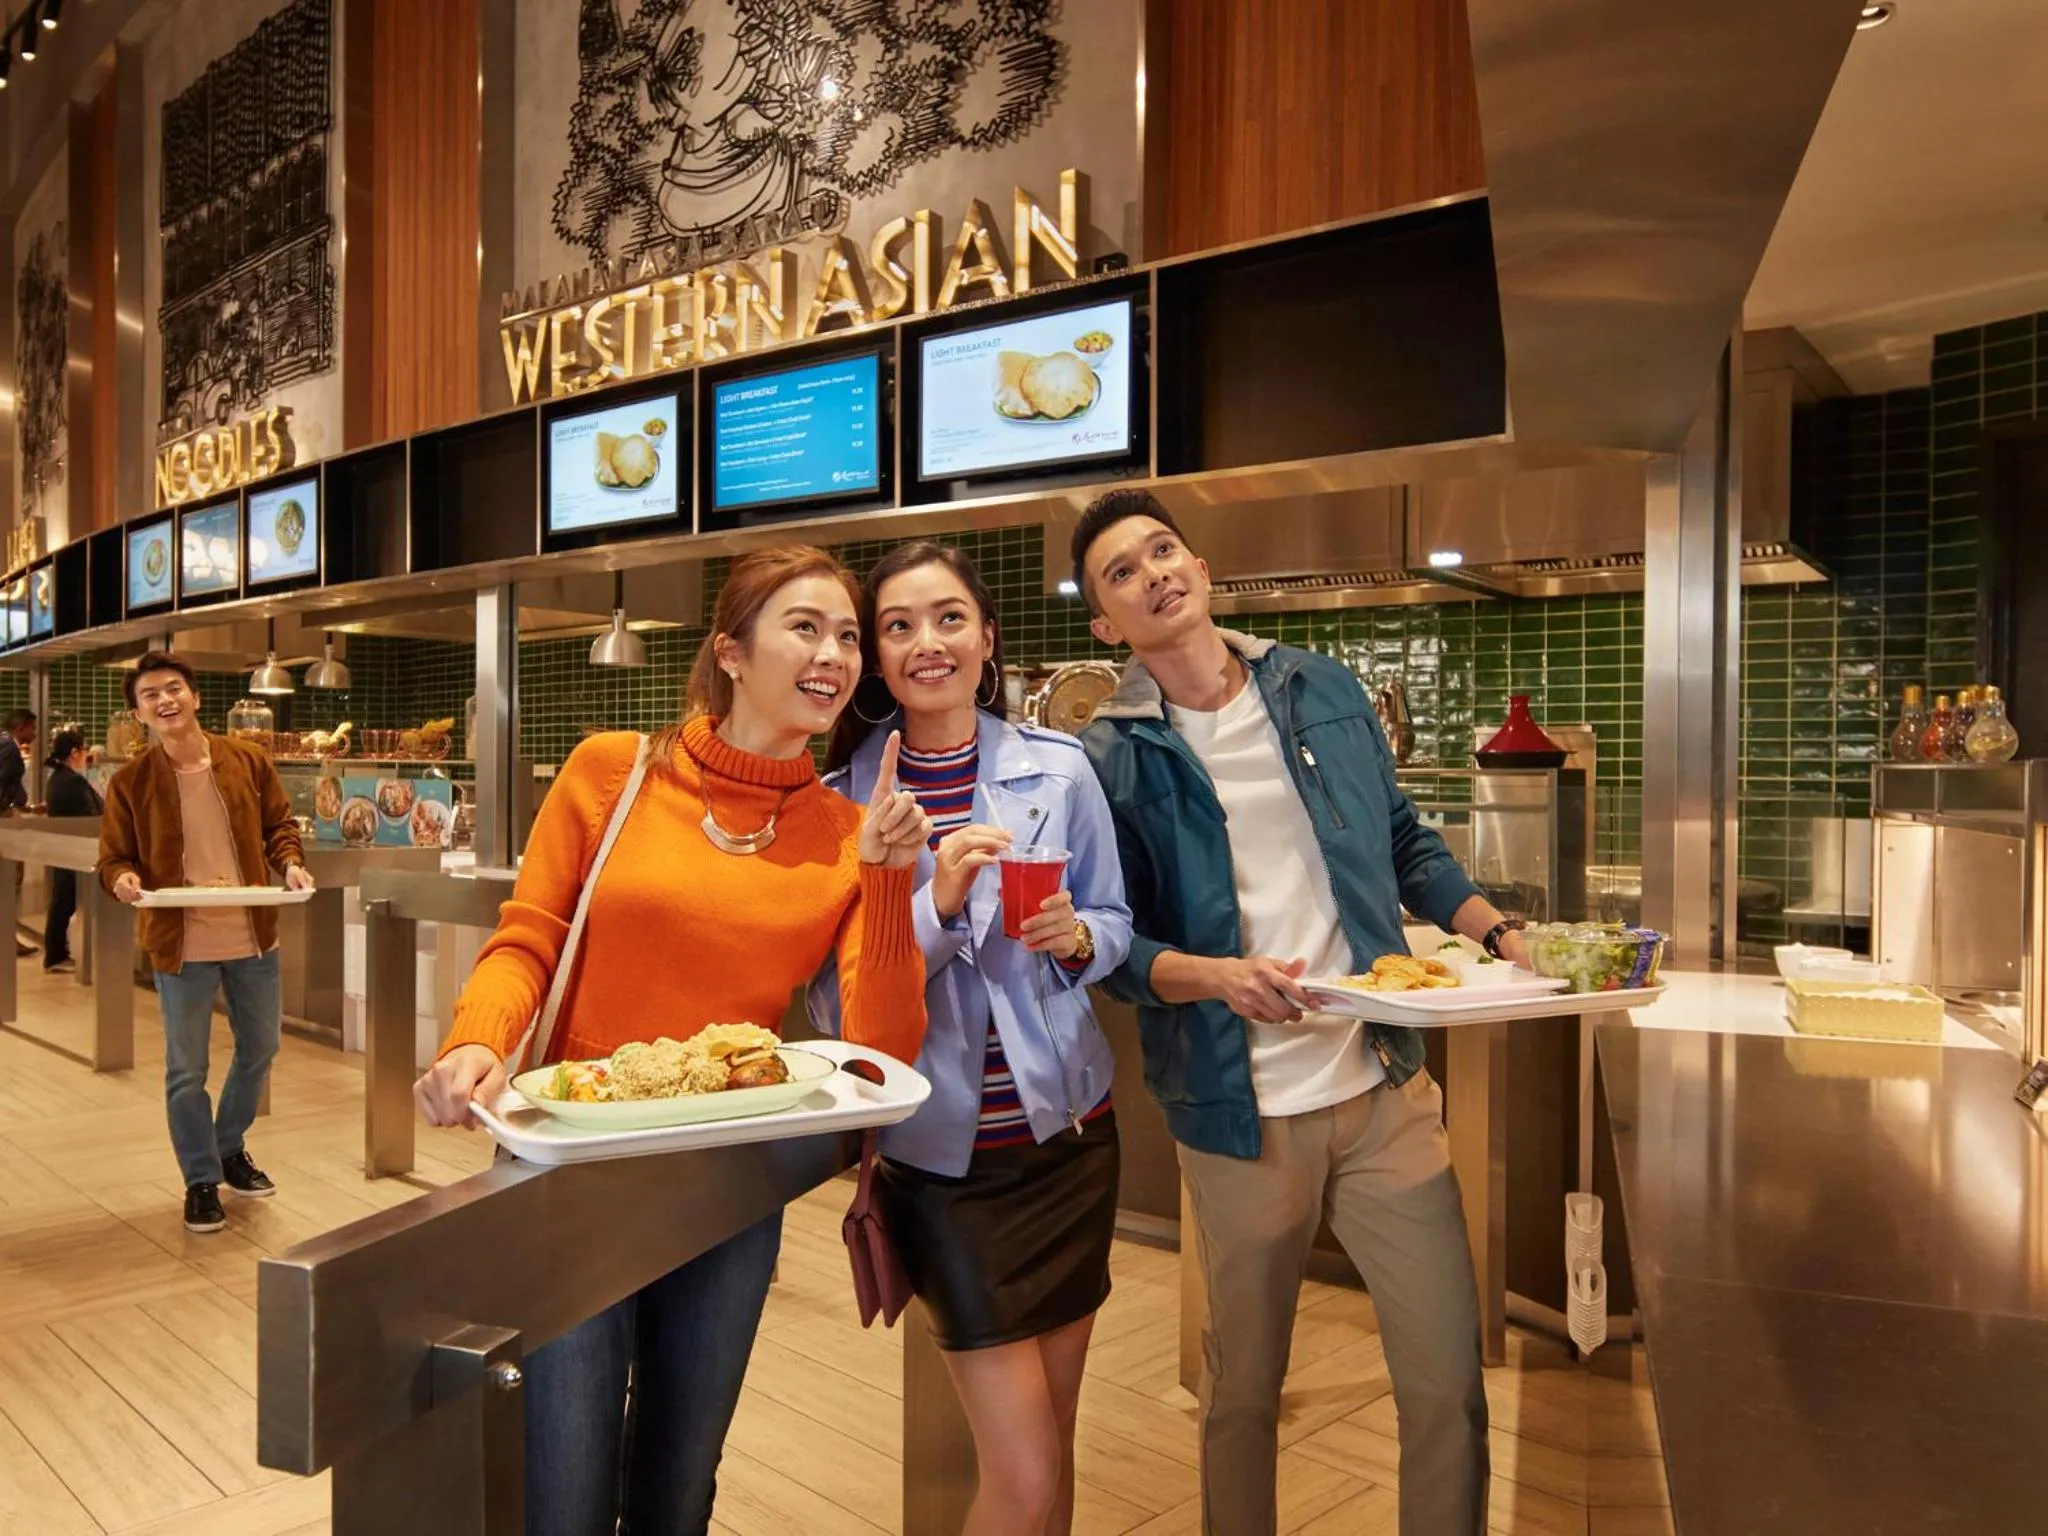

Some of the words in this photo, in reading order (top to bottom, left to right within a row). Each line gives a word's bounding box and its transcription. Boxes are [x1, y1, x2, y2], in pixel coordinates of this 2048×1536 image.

[501, 247, 792, 404] WESTERN
[804, 168, 1088, 338] ASIAN
[930, 346, 955, 359] LIGHT
[956, 338, 1002, 354] BREAKFAST
[720, 392, 740, 404] LIGHT
[740, 385, 779, 400] BREAKFAST
[155, 406, 294, 509] NOODLES
